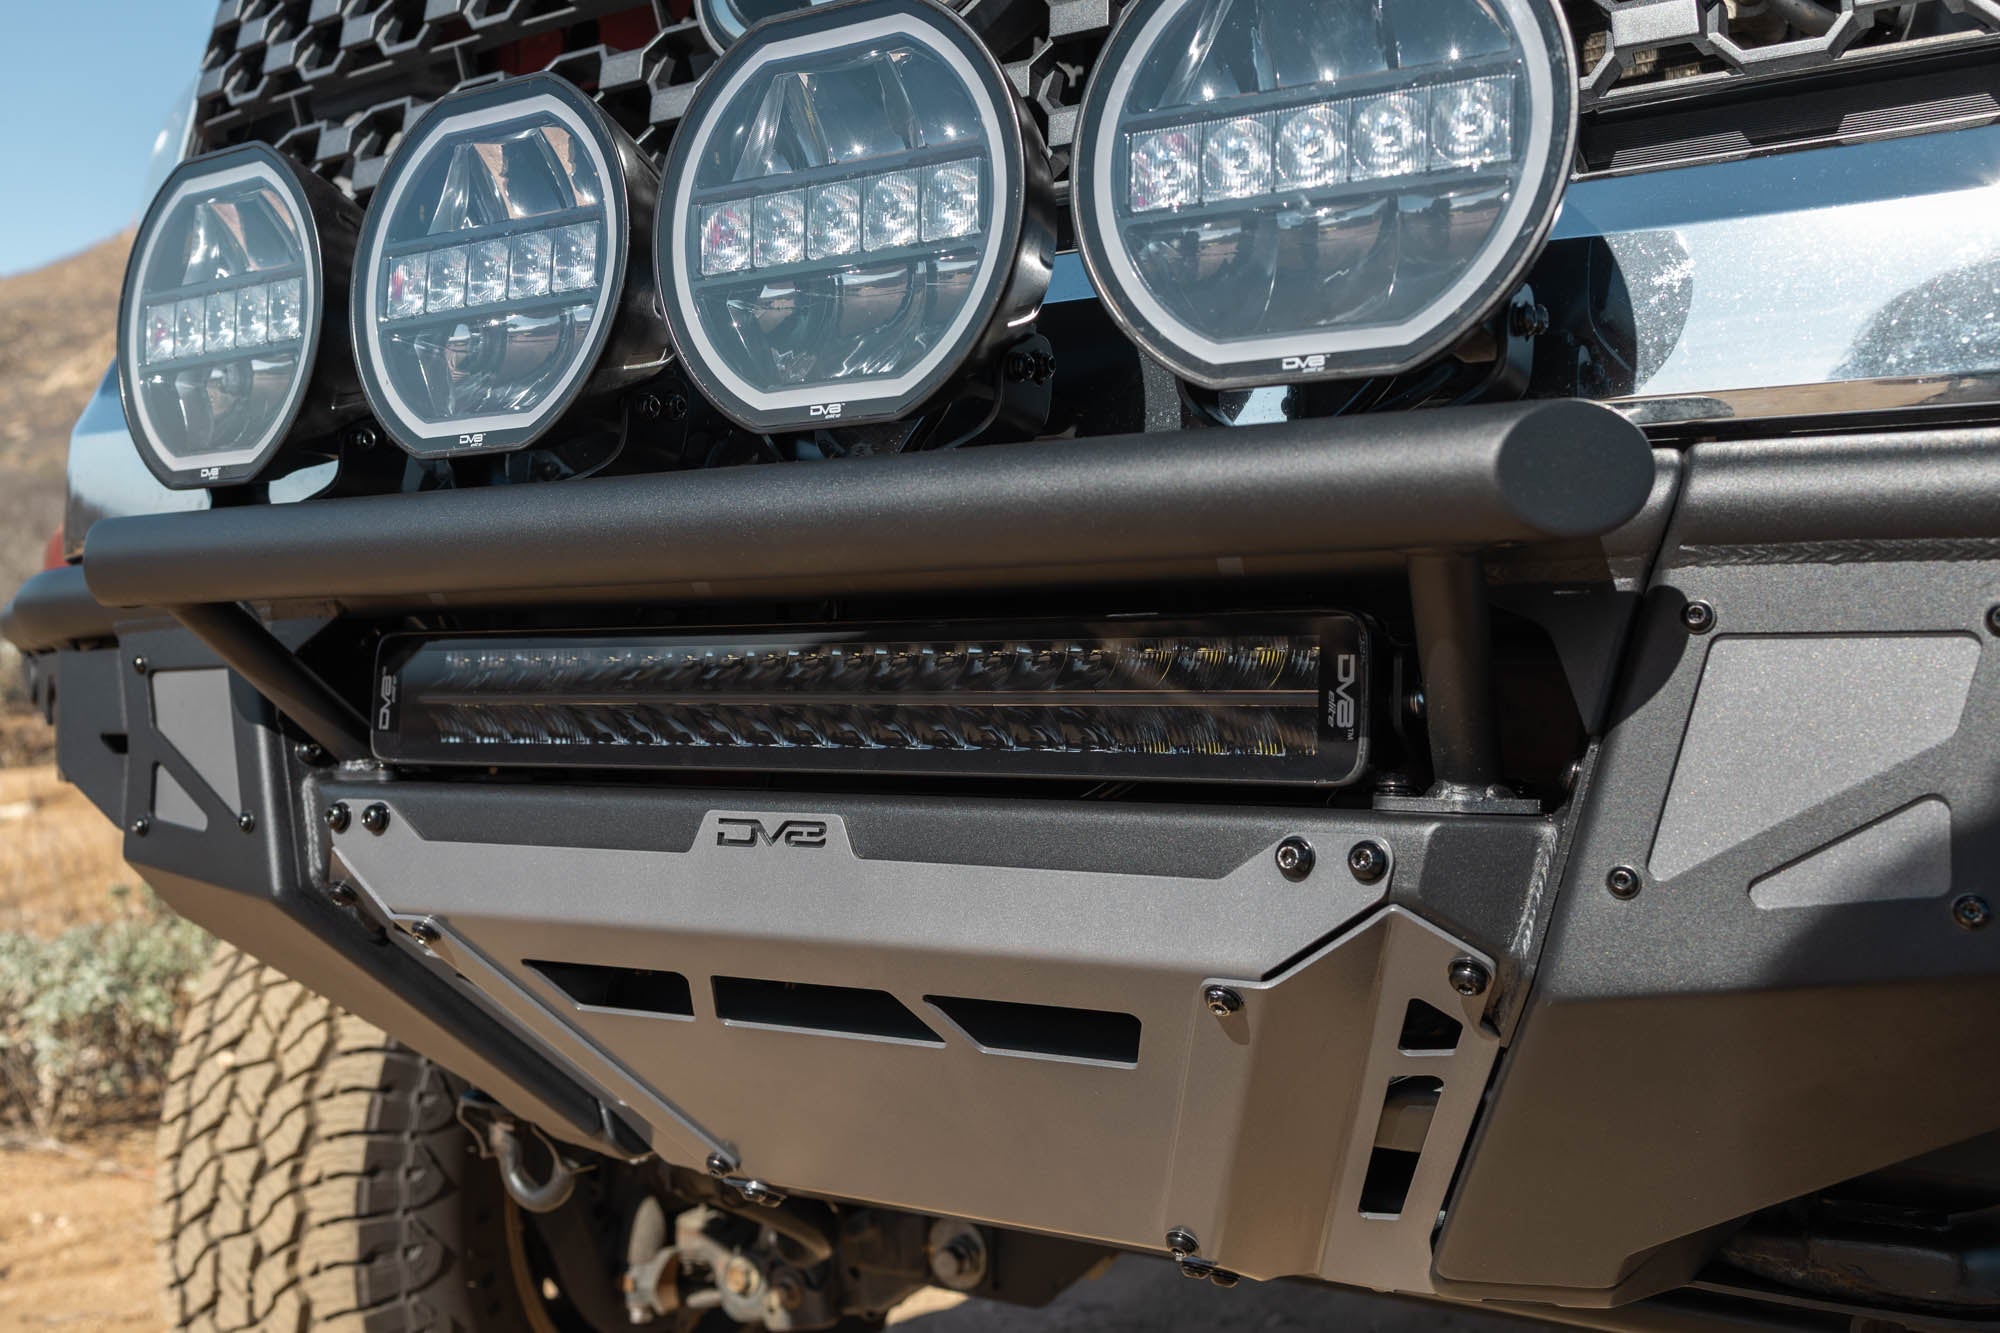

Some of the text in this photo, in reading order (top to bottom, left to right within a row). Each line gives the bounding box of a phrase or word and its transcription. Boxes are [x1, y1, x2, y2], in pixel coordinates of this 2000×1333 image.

[1282, 354, 1325, 370] DV8
[810, 404, 841, 416] DV8
[459, 433, 483, 444] DV8
[1336, 654, 1355, 728] DV8
[378, 675, 392, 730] DV8
